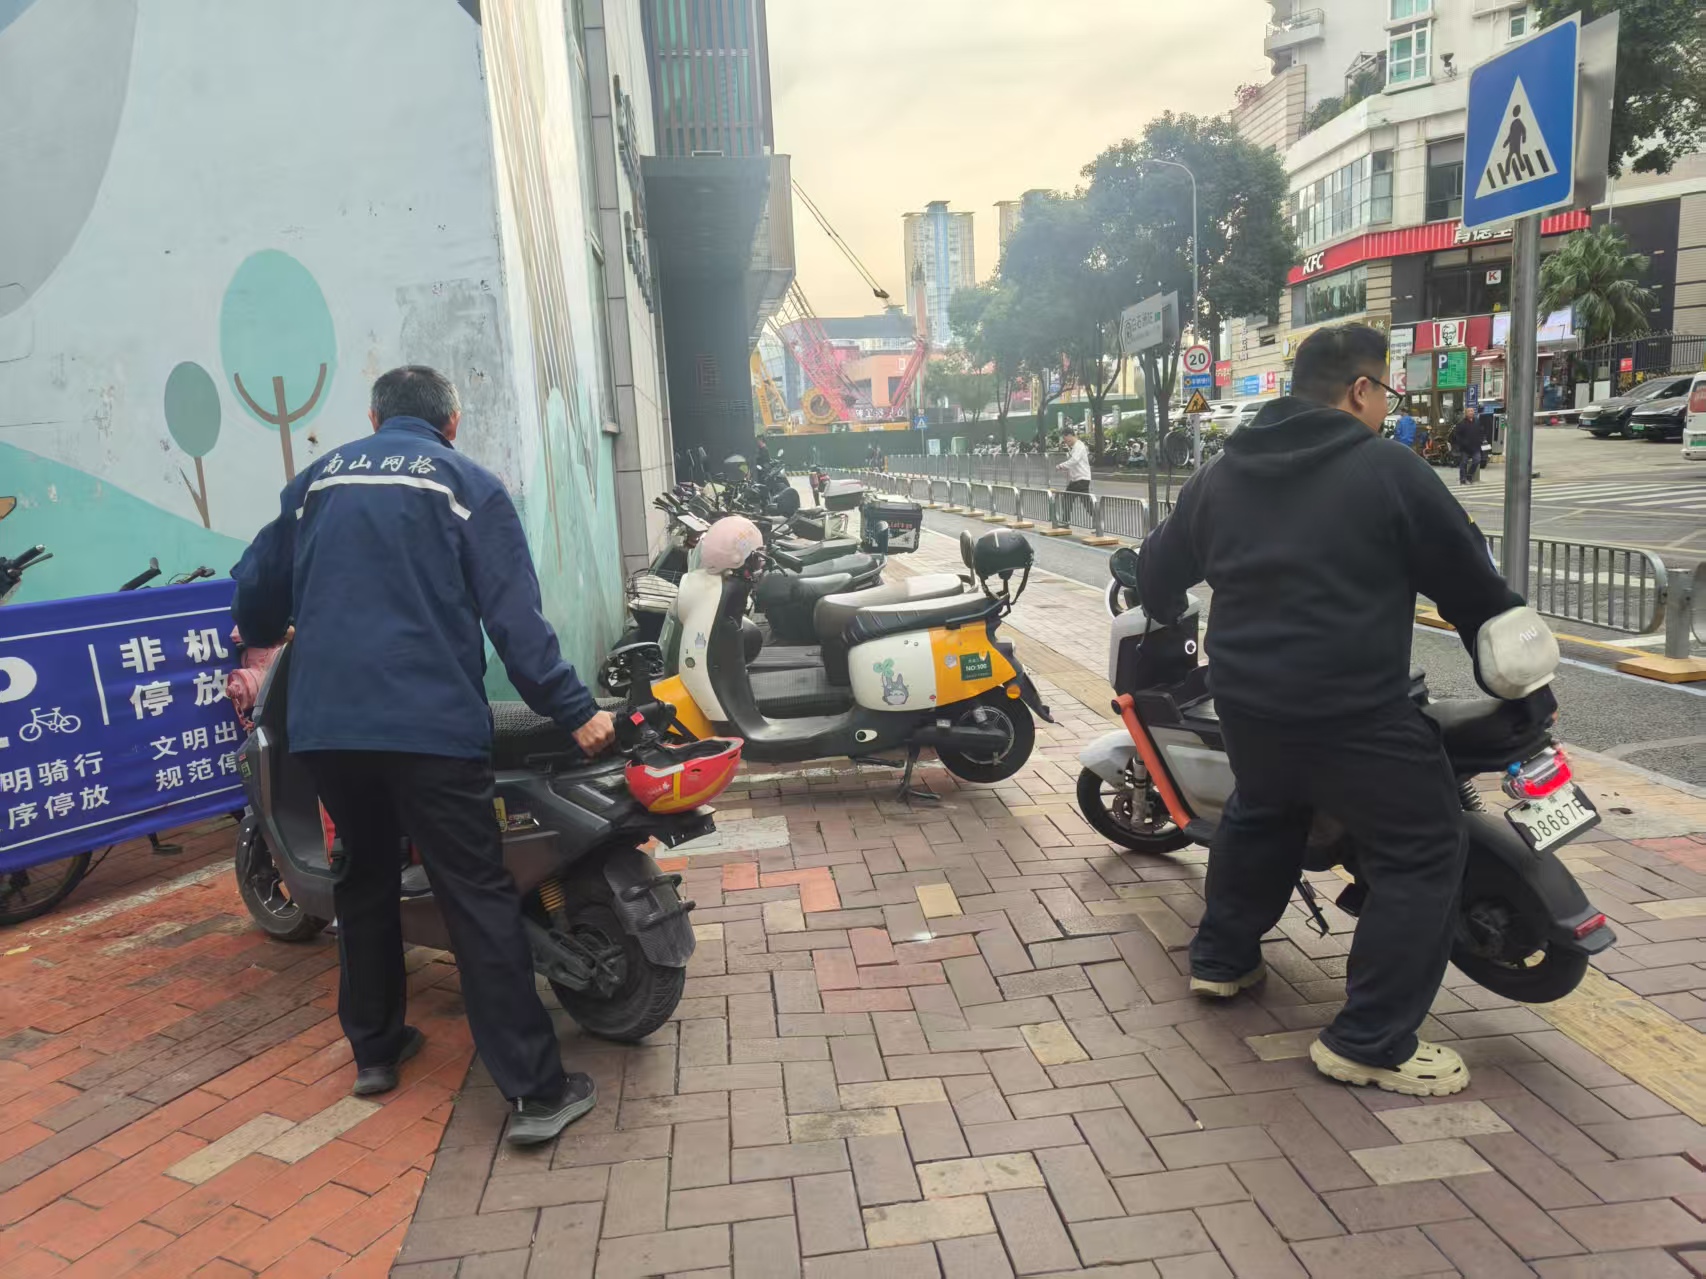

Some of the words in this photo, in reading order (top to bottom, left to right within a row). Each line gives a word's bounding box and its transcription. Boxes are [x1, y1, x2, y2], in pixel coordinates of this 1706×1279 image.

[1303, 252, 1324, 276] KFC
[1488, 271, 1498, 281] K
[1190, 352, 1206, 366] 20
[1438, 354, 1448, 369] P
[323, 453, 437, 475] 南山网格
[119, 628, 229, 674] 非机
[129, 669, 230, 720] 停放
[149, 721, 238, 760] 文明出
[155, 751, 237, 792] 规范停
[8, 784, 110, 830] 序停放
